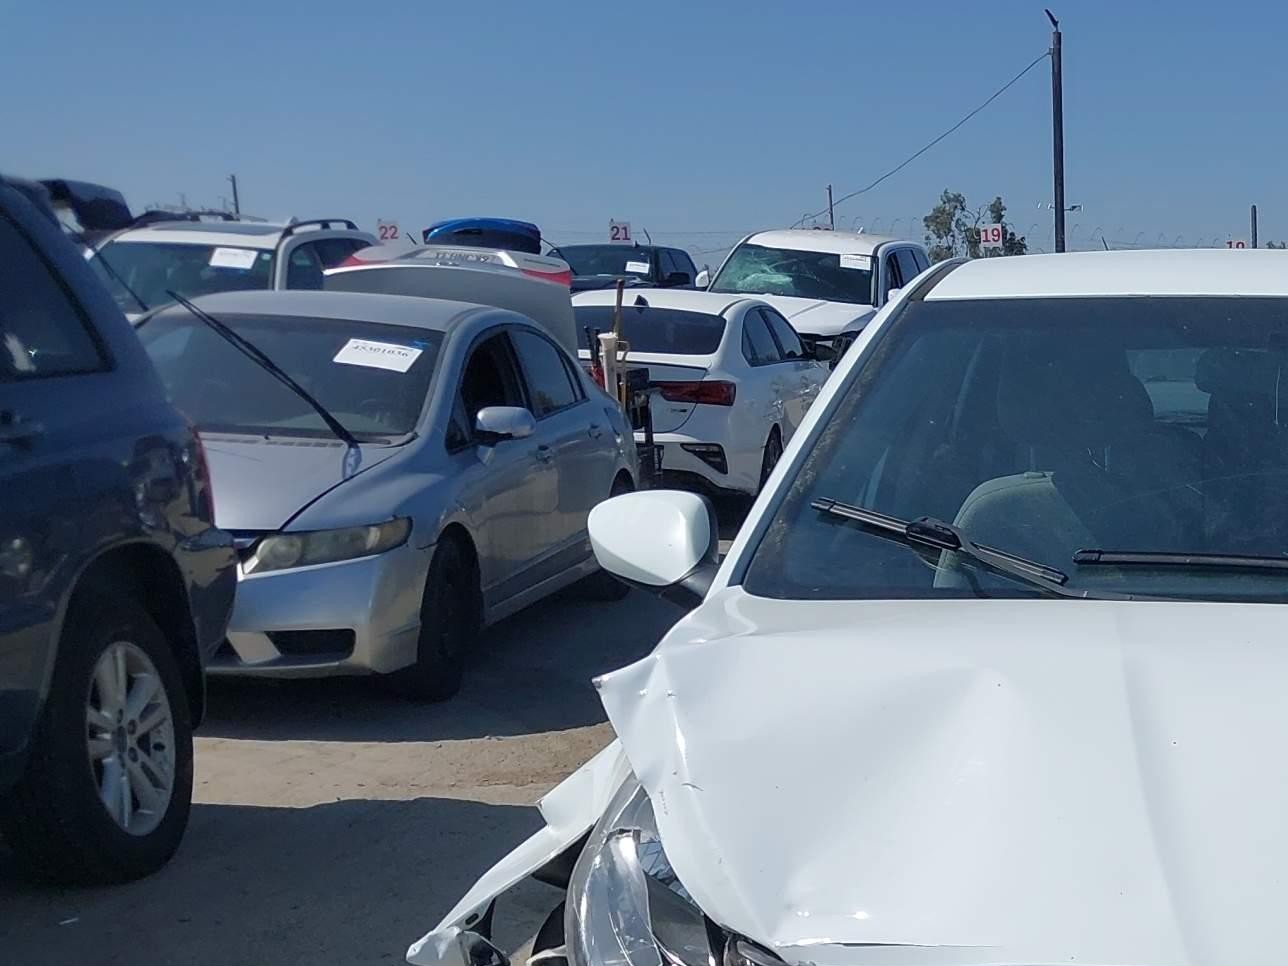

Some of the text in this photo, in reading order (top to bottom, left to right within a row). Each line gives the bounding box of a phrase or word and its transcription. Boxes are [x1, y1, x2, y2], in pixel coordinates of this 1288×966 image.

[379, 225, 399, 240] 22
[610, 225, 631, 241] 21
[981, 228, 1001, 243] 19
